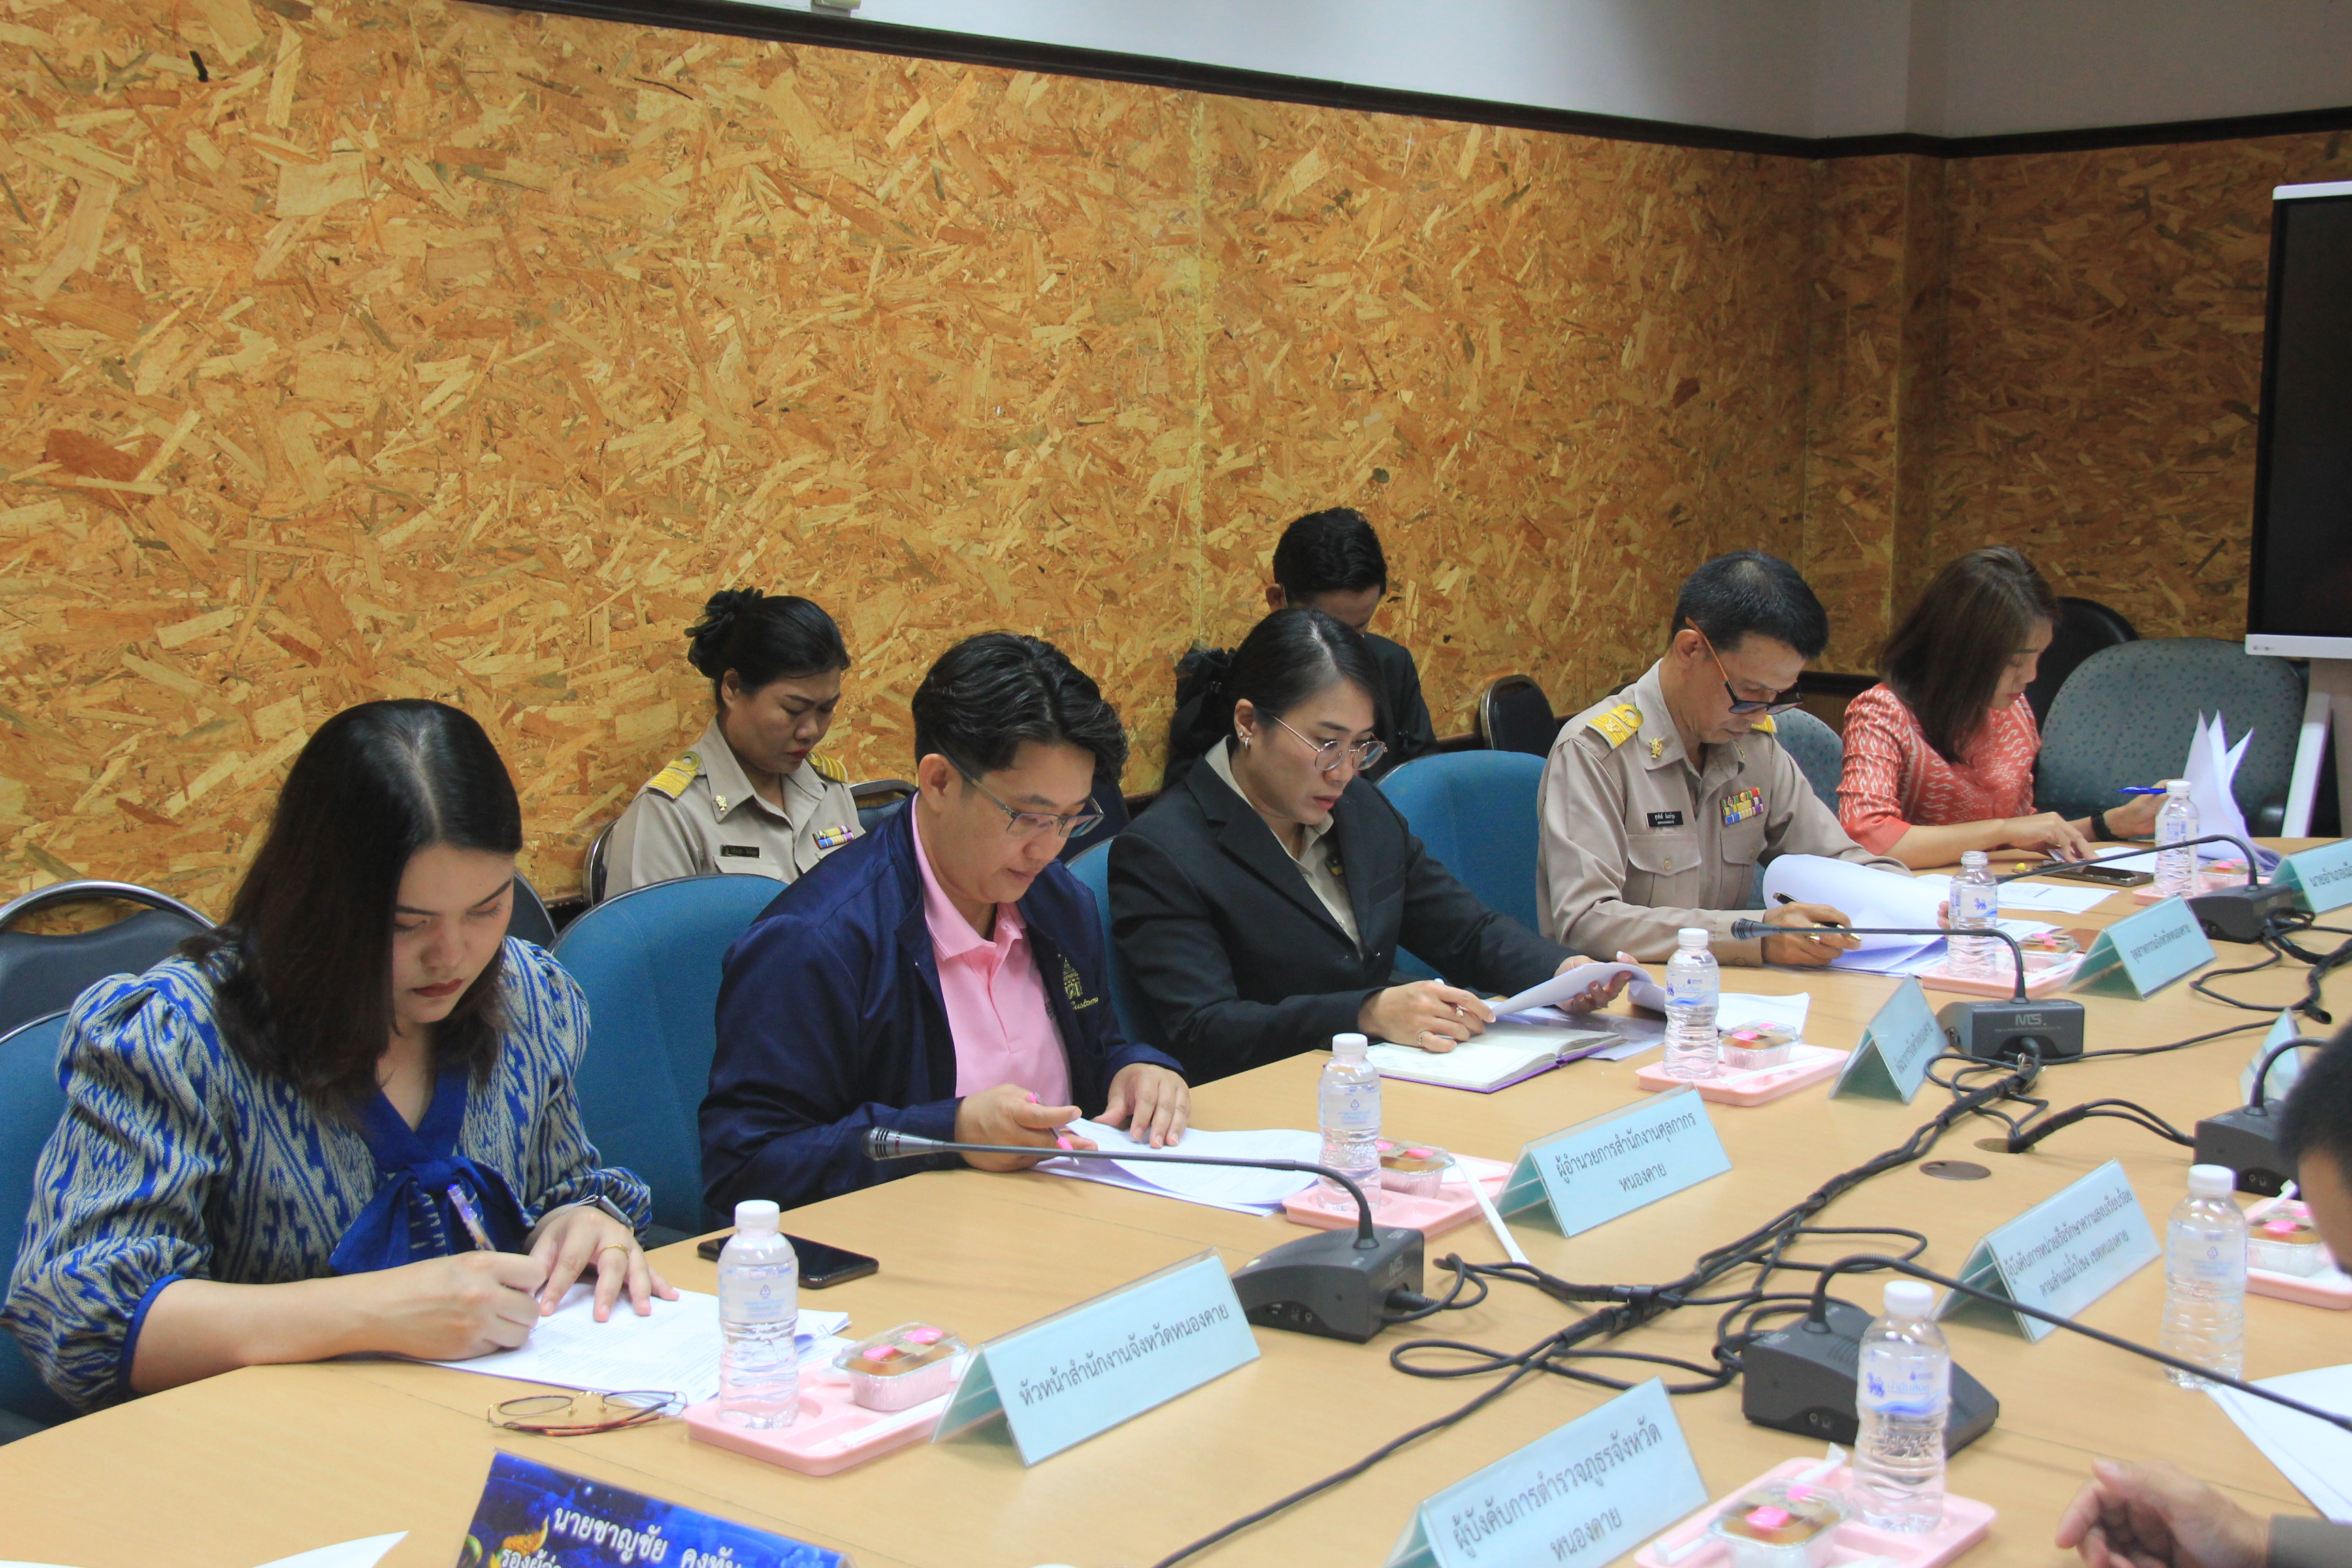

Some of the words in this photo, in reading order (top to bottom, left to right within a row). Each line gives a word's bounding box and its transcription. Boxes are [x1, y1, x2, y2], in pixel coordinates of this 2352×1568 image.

[1555, 1111, 1697, 1184] ผู้อำนวยการสำนักงานศุลกากร
[1618, 1161, 1667, 1193] หนองคาย
[2004, 1188, 2133, 1285] ผู้บังคับการหน่วยเรือรักษาความสงบเรียบร้อย
[2089, 1229, 2129, 1264] เขตหนองคาย
[1018, 1302, 1229, 1407] หัวหน้าสำนักงานจังหวัดหนองคาย
[1453, 1415, 1663, 1558] ผู้บังคับการตำรวจภูธรจังหวัด
[553, 1506, 670, 1565] นายชาญชัย
[680, 1545, 742, 1568] คงทั
[1550, 1505, 1622, 1562] หนองคาย
